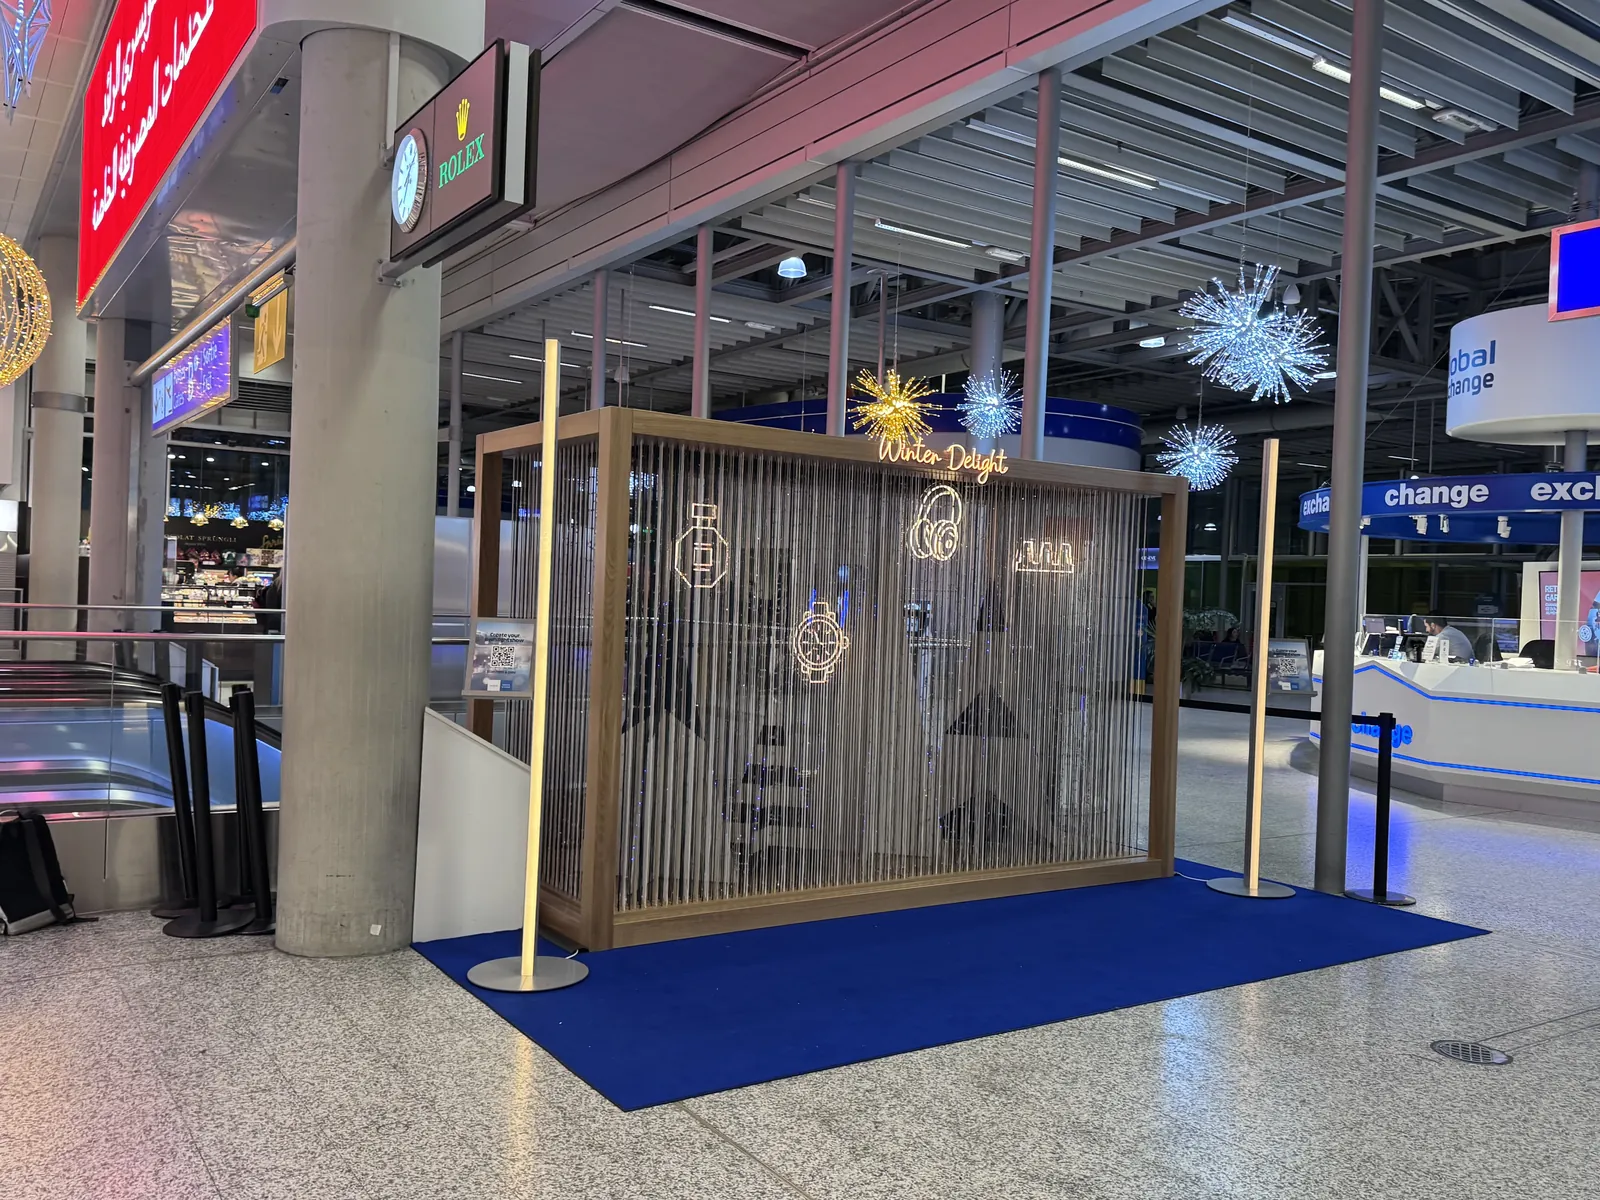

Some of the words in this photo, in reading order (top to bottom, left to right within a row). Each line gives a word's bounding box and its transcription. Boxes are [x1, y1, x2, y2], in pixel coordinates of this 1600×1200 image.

[438, 133, 485, 189] ROLEX
[879, 434, 942, 465] Winter
[945, 444, 1009, 484] Delight
[1384, 483, 1489, 509] change
[1351, 711, 1413, 748] chage
